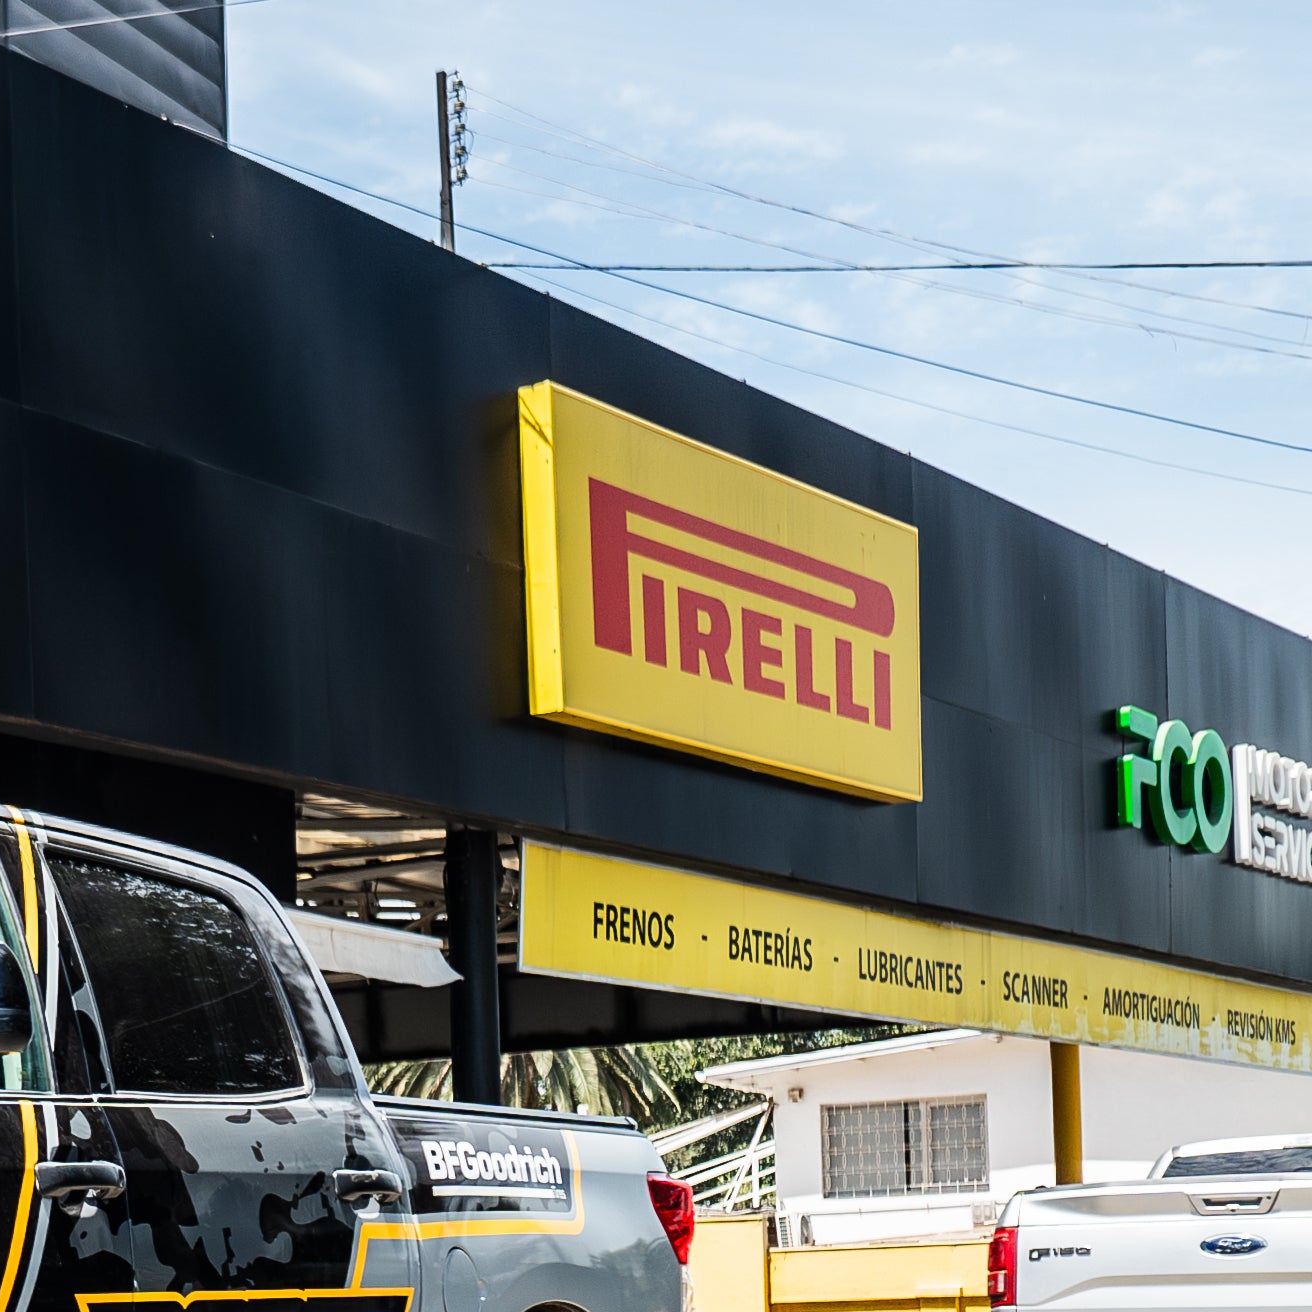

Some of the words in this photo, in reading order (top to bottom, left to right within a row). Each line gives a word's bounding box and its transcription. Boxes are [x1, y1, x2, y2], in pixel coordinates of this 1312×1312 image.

[588, 476, 896, 731] PIRELLI
[1117, 704, 1233, 854] FCO
[1248, 744, 1312, 818] MOTO
[593, 902, 675, 950] FRENOS
[728, 927, 813, 972] BATERÍAS
[858, 947, 963, 996] LUBRICANTES
[1003, 970, 1069, 1010] SCANNER
[1103, 985, 1201, 1031] AMORTIGUACIÓN
[1227, 1008, 1273, 1043] REVISIÓN
[1275, 1018, 1297, 1046] KMS
[421, 1140, 564, 1185] BFGoodrich
